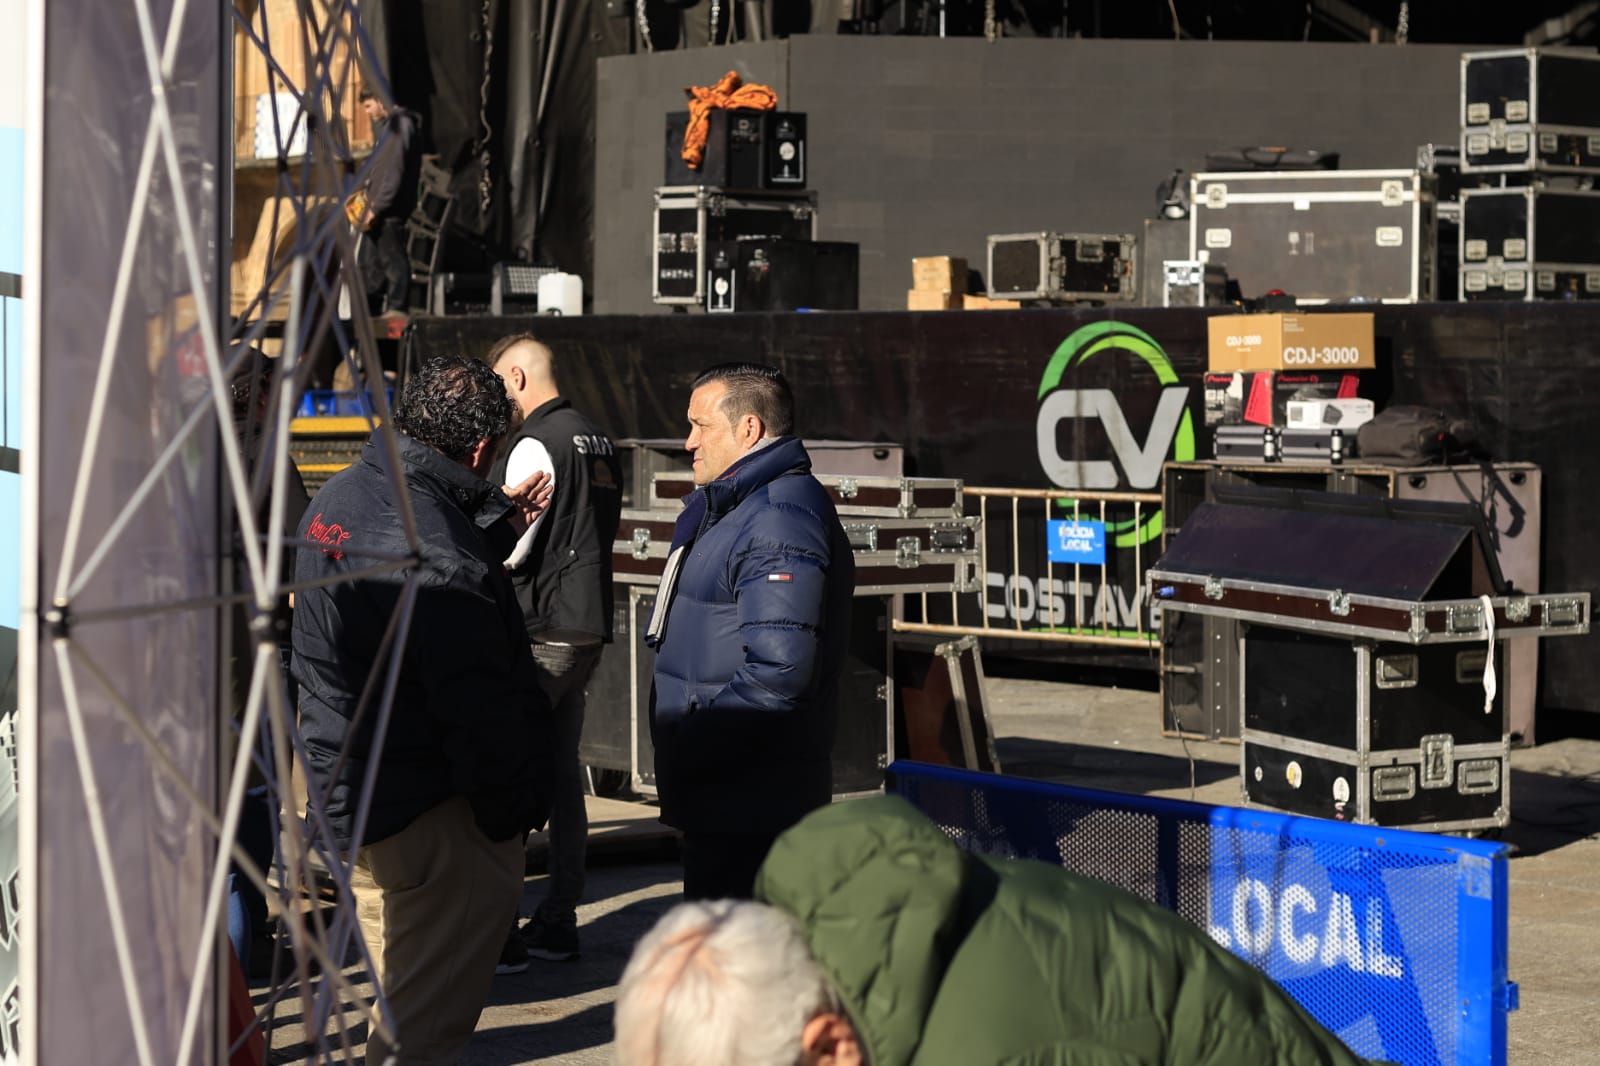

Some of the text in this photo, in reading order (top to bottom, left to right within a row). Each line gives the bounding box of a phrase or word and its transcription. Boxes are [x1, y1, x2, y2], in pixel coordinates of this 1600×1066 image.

[1226, 335, 1262, 346] CDJ-3000
[1283, 346, 1359, 365] CDJ-3000
[1036, 386, 1190, 489] CV
